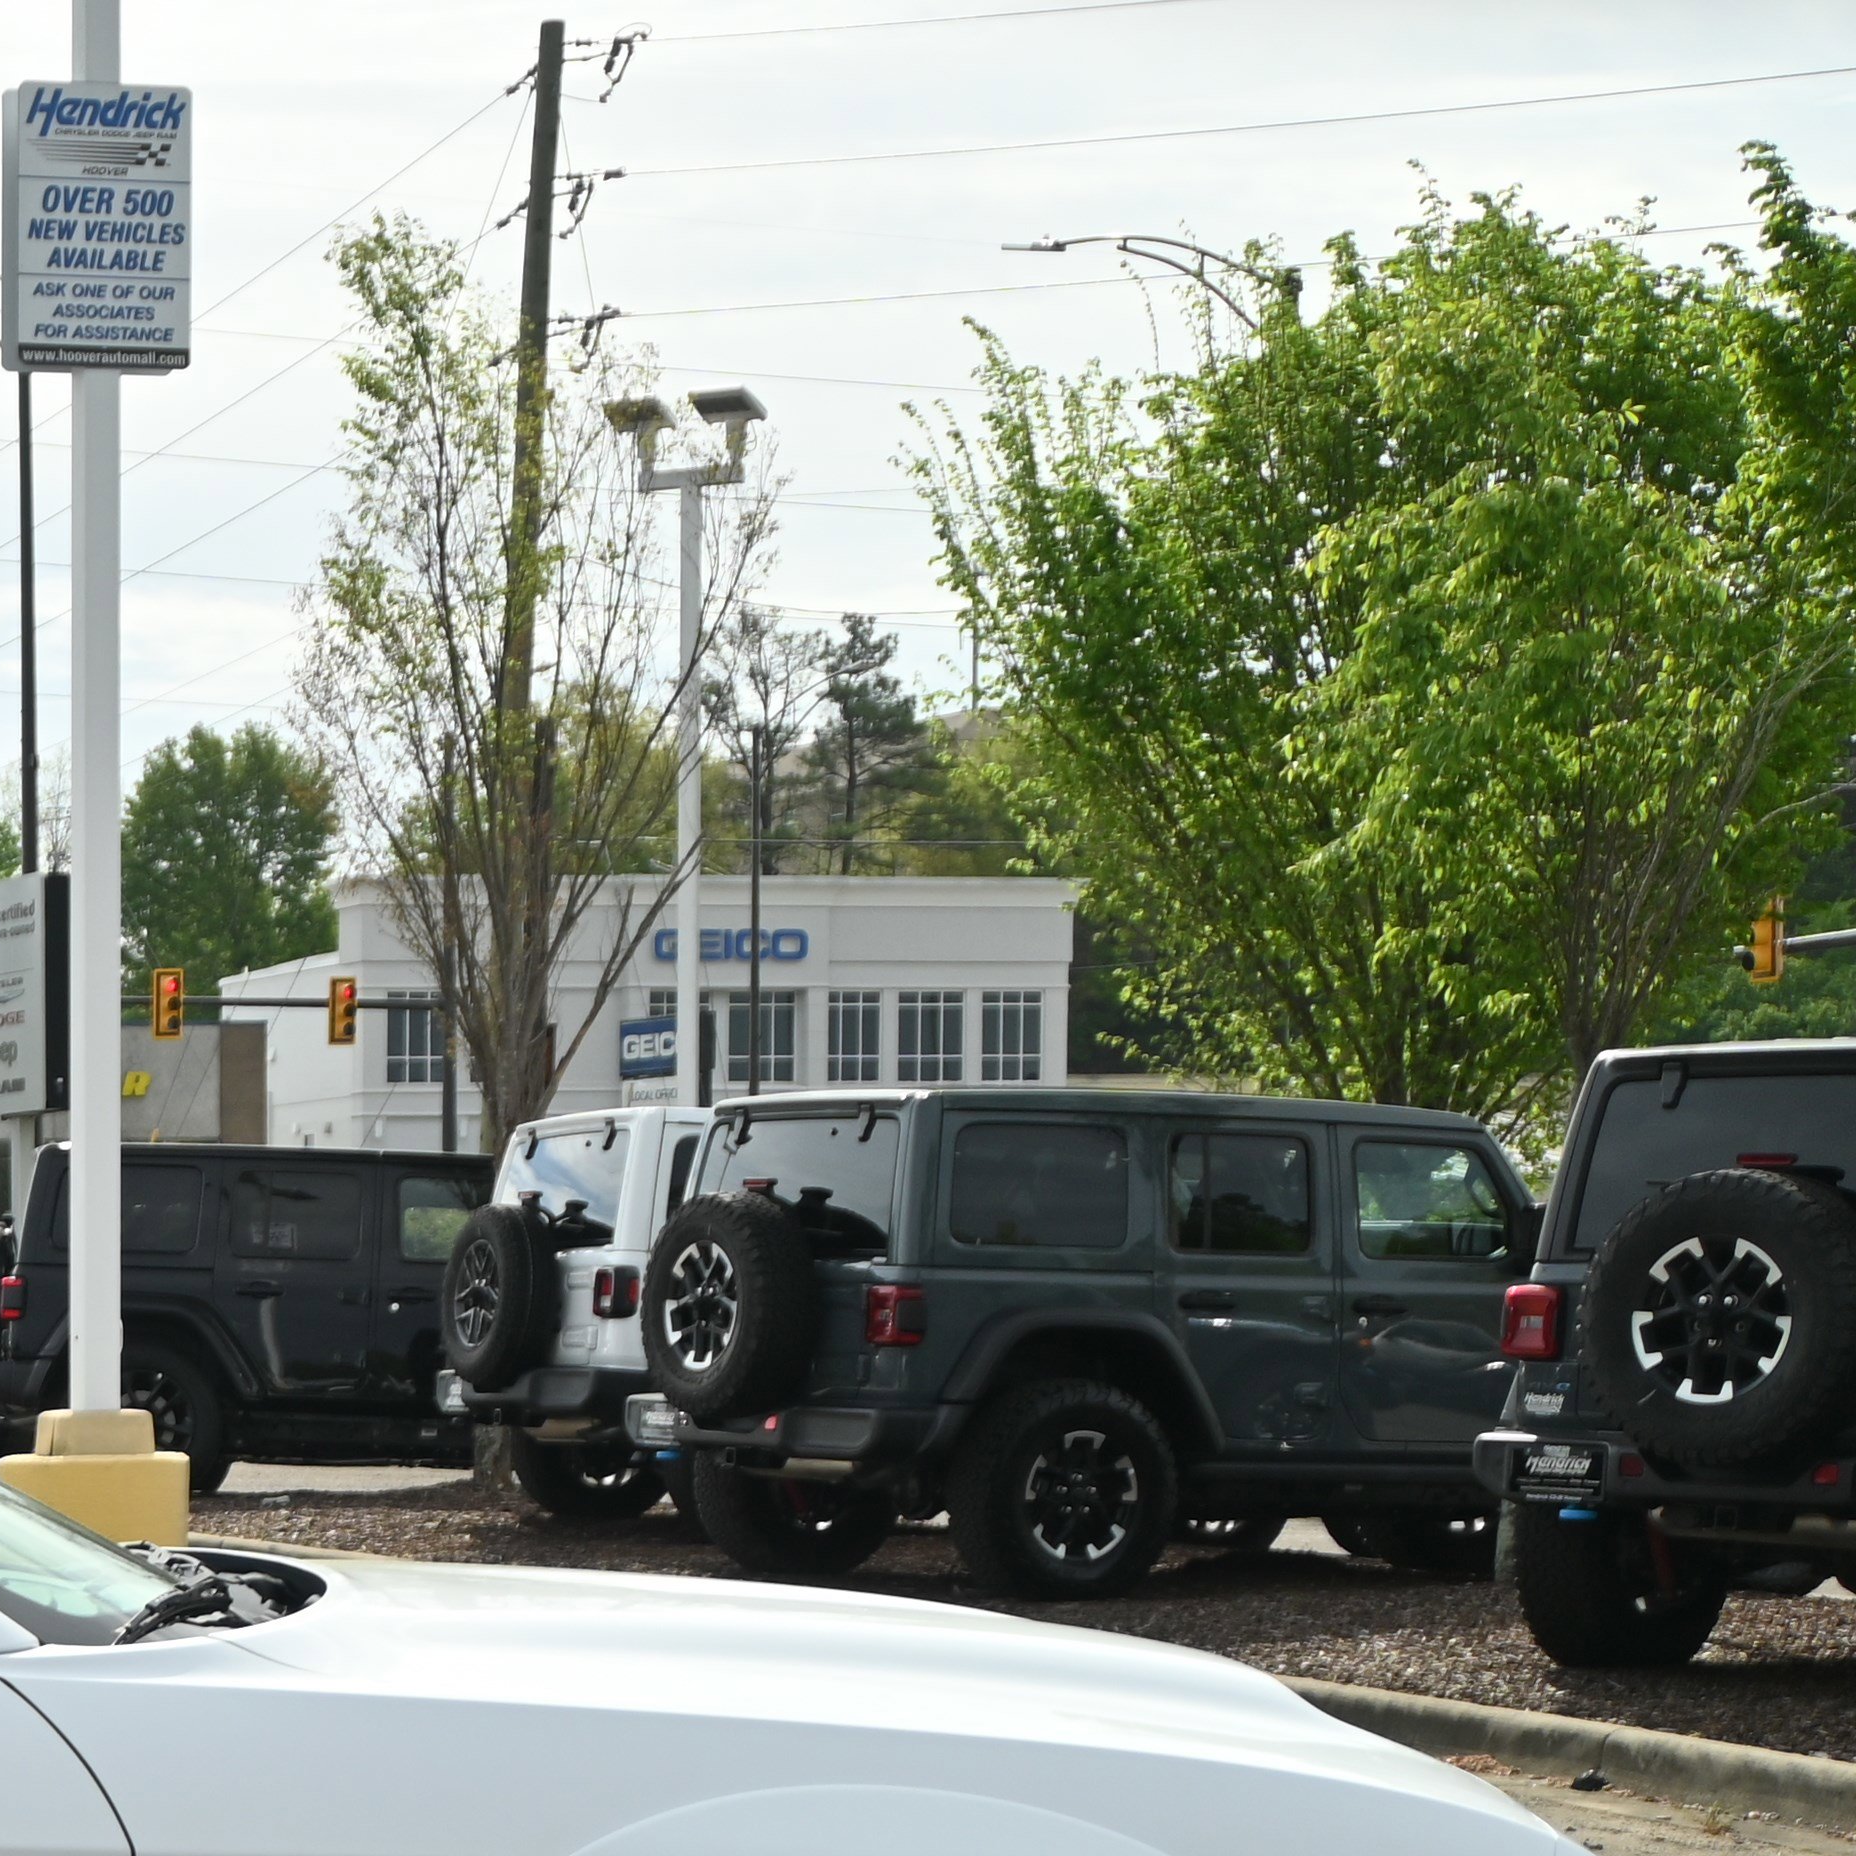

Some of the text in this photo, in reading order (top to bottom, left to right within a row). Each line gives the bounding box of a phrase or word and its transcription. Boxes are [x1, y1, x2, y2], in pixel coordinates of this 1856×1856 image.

[26, 87, 186, 137] Hendrick
[54, 128, 99, 137] CHRYSLER
[81, 165, 129, 176] HOOVER
[42, 184, 174, 217] OVER 500
[28, 218, 186, 245] NEW VEHICLES
[46, 246, 166, 272] AVAILABLE
[33, 282, 176, 301] ASK ONE OF OUR
[52, 303, 156, 321] ASSOCIATES
[34, 323, 175, 342] FOR ASSISTANCE
[22, 348, 186, 366] www.hooverautomall.com
[654, 928, 810, 961] GEICO
[623, 1031, 676, 1060] GEIC
[1525, 1455, 1592, 1475] Hendrick
